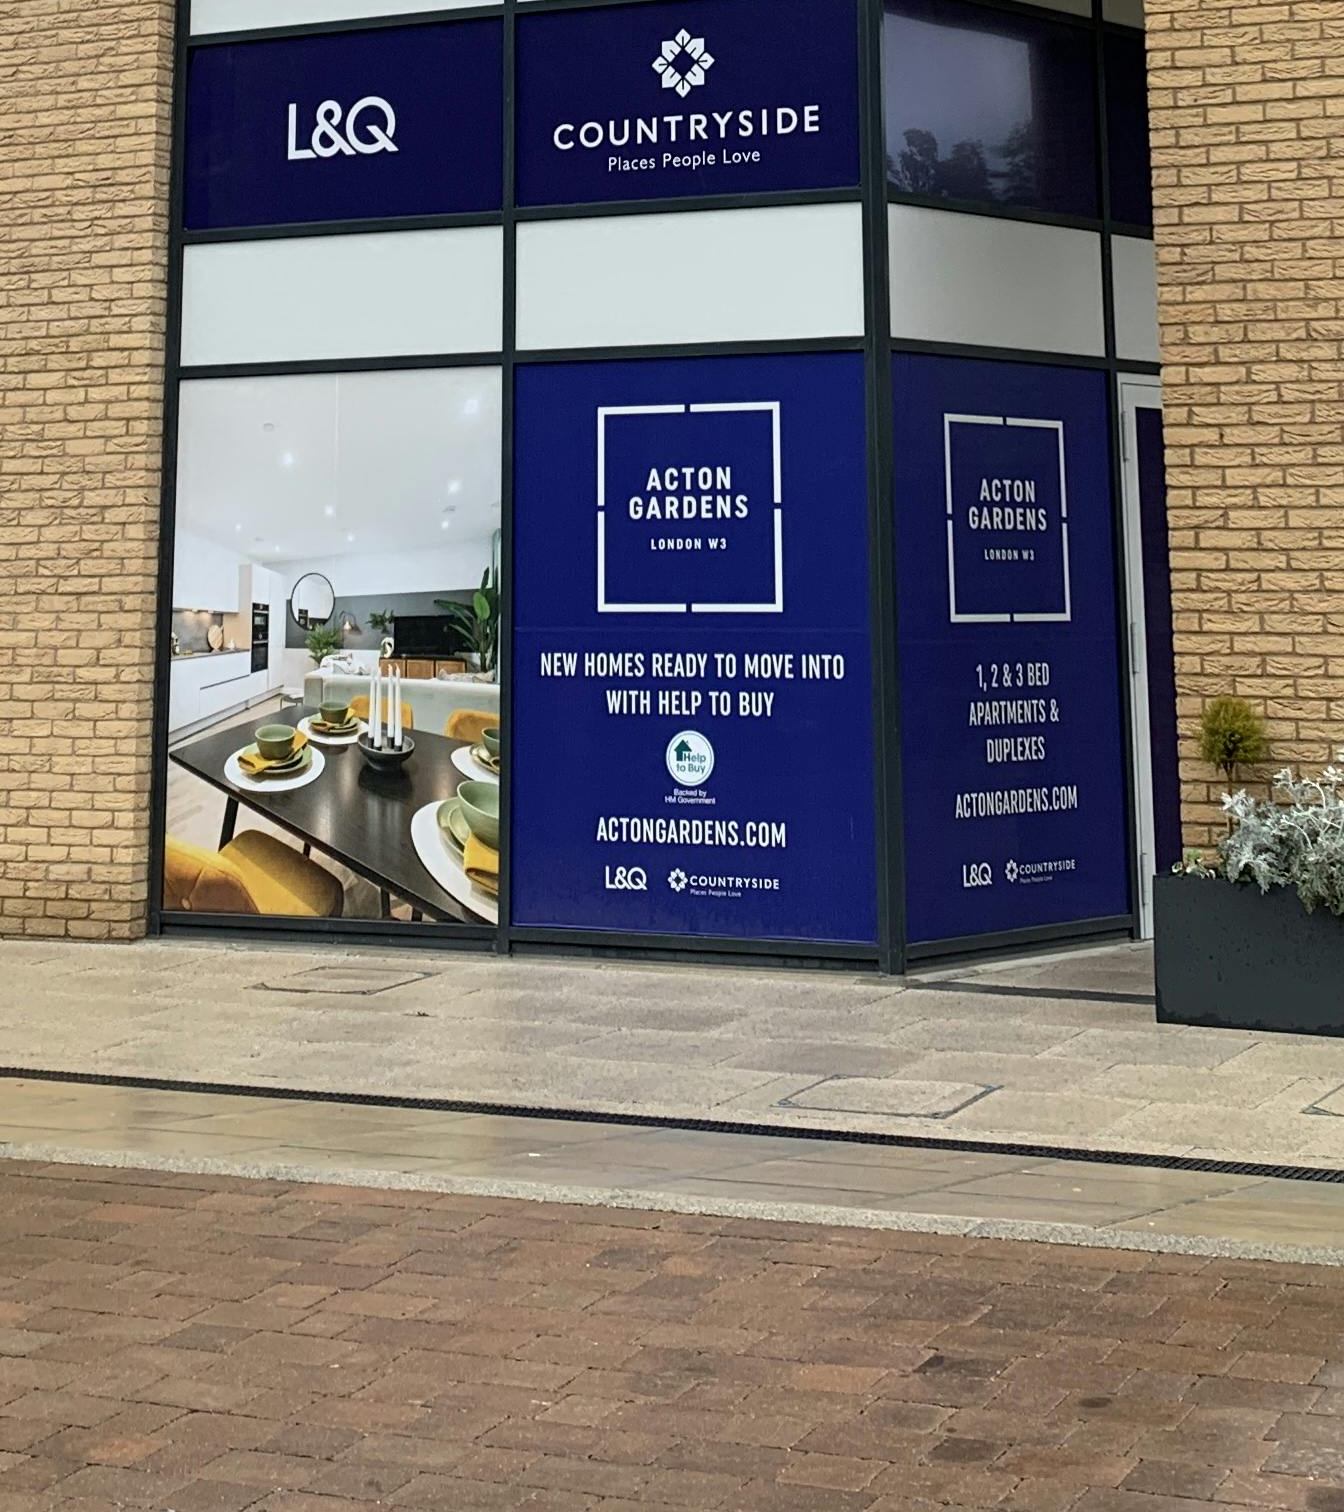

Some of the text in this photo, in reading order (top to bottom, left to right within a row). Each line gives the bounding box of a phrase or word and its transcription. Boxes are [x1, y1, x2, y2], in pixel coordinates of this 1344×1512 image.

[288, 96, 398, 160] L&Q
[554, 105, 819, 152] COUNTRYSIDE
[609, 149, 760, 171] Places People Love
[647, 467, 730, 491] ACTON
[980, 479, 1035, 502] ACTON
[630, 495, 748, 519] GARDENS
[969, 507, 1046, 530] GARDENS
[651, 538, 726, 550] LONDON W3
[985, 549, 1034, 560] LONDON W3
[541, 653, 844, 679] NEW HOMES READY TO MOVE INTO
[976, 663, 1049, 691] 1, 2 & 3 BED
[606, 690, 774, 716] WITH HELP TO BUY
[970, 699, 1059, 725] APARTMENTS &
[684, 752, 706, 763] Help
[987, 736, 1045, 762] DUPLEXES
[677, 763, 705, 774] to Buy
[956, 786, 1077, 818] ACTONGARDENS.COM
[597, 817, 785, 847] ACTONGARDENS.COM
[606, 866, 779, 890] L&Q COUNTRYSIDE
[963, 859, 1075, 887] L&Q COUNTRYSIDE
